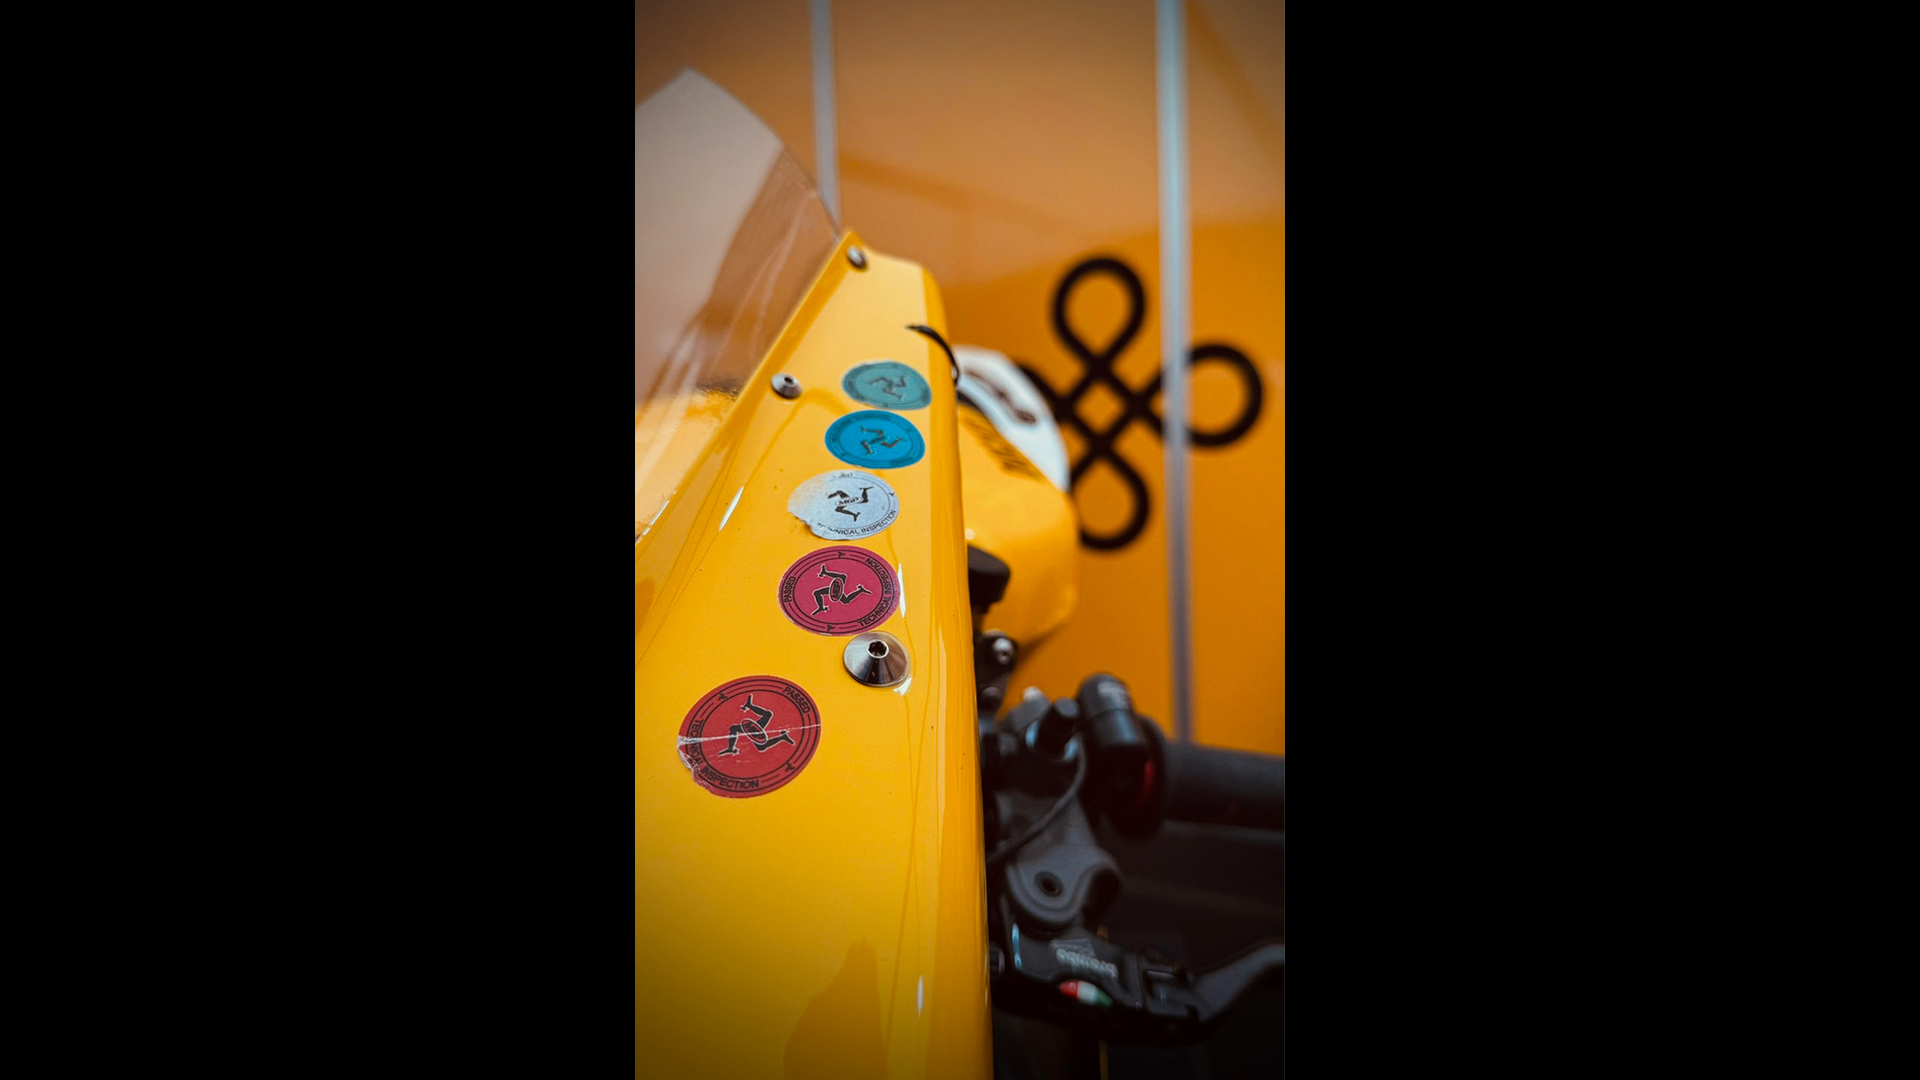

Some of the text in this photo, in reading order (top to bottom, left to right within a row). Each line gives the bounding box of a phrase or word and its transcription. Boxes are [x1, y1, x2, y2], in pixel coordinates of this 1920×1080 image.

[861, 509, 896, 533] INSPECTION
[784, 576, 796, 602] PASSED
[857, 558, 892, 627] TECHNICAL INSPECTION
[783, 686, 811, 714] PASSED
[689, 718, 759, 788] TECNICAL INSPECTION
